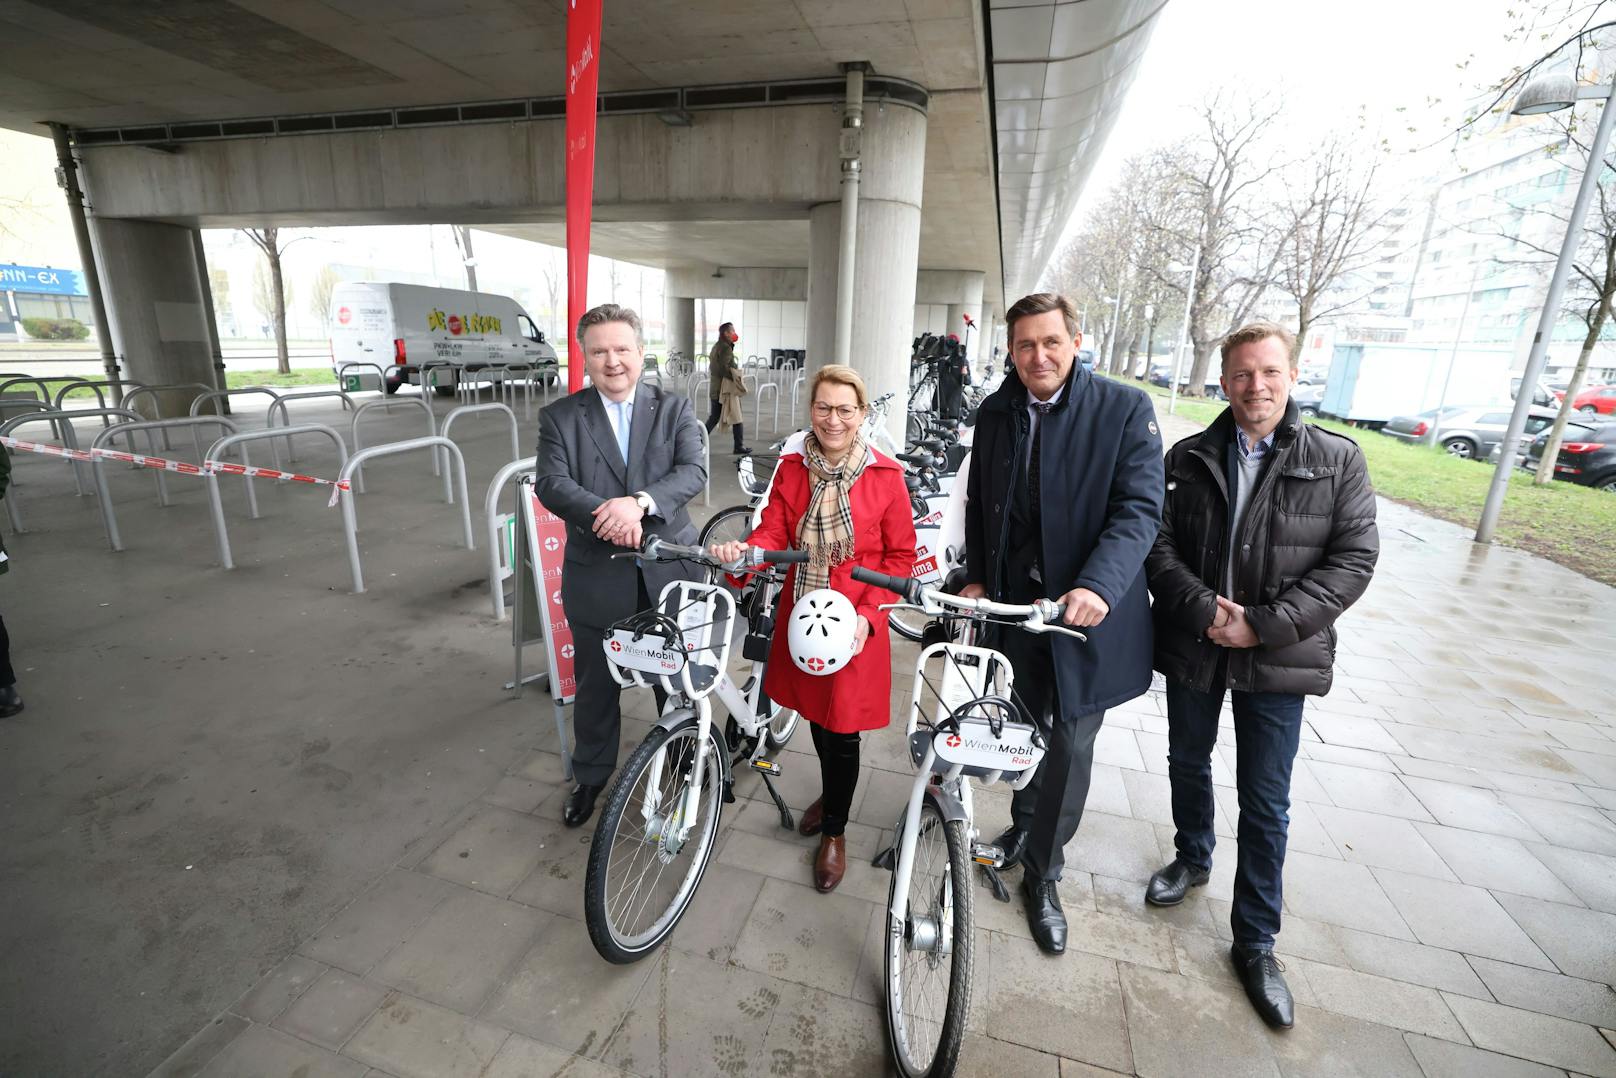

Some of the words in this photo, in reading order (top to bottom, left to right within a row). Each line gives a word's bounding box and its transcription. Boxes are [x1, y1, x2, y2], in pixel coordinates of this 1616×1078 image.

[623, 644, 675, 661] WienMobil
[660, 661, 676, 670] Rad
[964, 738, 1034, 756] WienMobil
[1011, 756, 1032, 765] Rad
